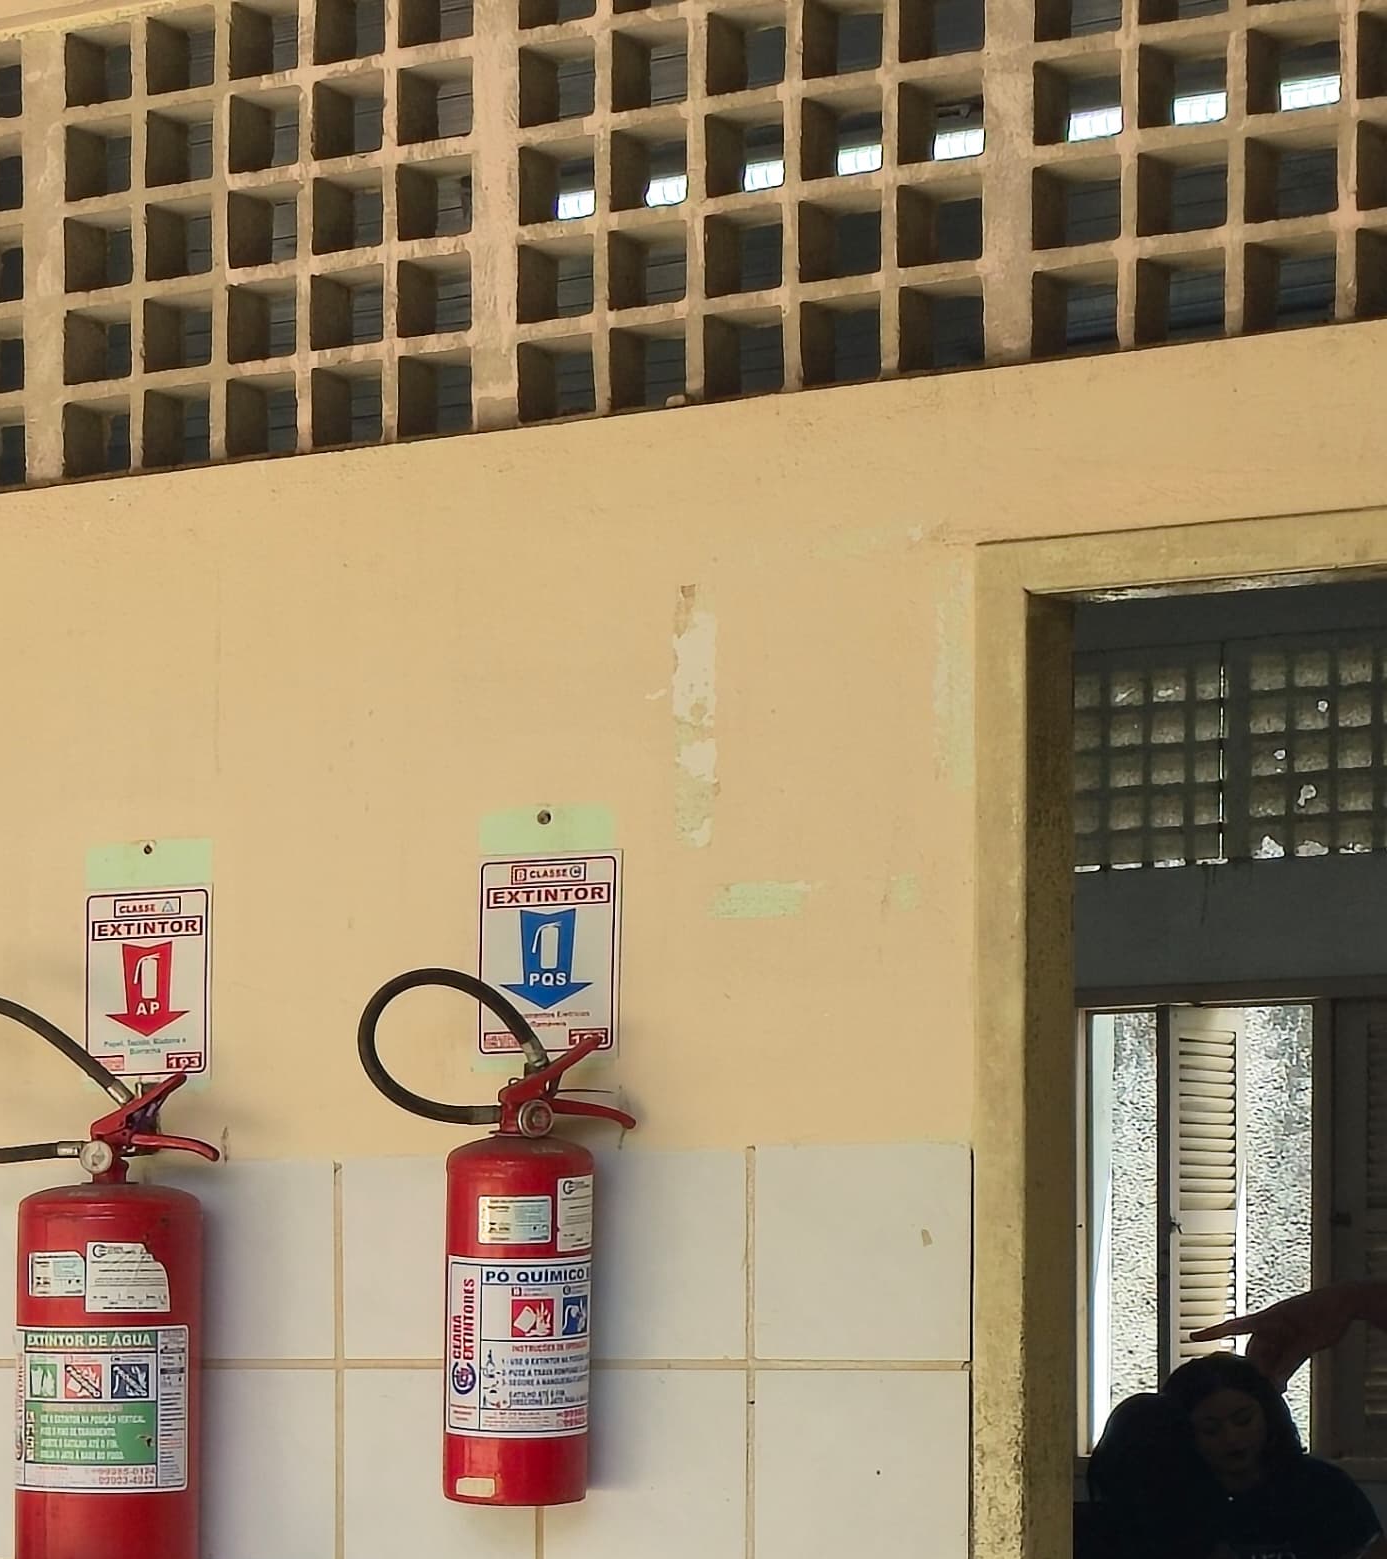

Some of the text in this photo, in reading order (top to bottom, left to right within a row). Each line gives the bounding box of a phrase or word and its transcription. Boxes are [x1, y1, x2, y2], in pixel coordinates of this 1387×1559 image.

[530, 869, 567, 879] CLASSE
[492, 887, 604, 904] EXTINTOR
[119, 904, 155, 913] CLASSE
[97, 920, 197, 936] EXTINTOR
[529, 973, 567, 986] PQS
[136, 1002, 160, 1015] AP
[169, 1057, 200, 1068] 193
[486, 1268, 585, 1282] PÓ QUÍMICO
[27, 1332, 151, 1346] EXTINTOR DE ÁGUA
